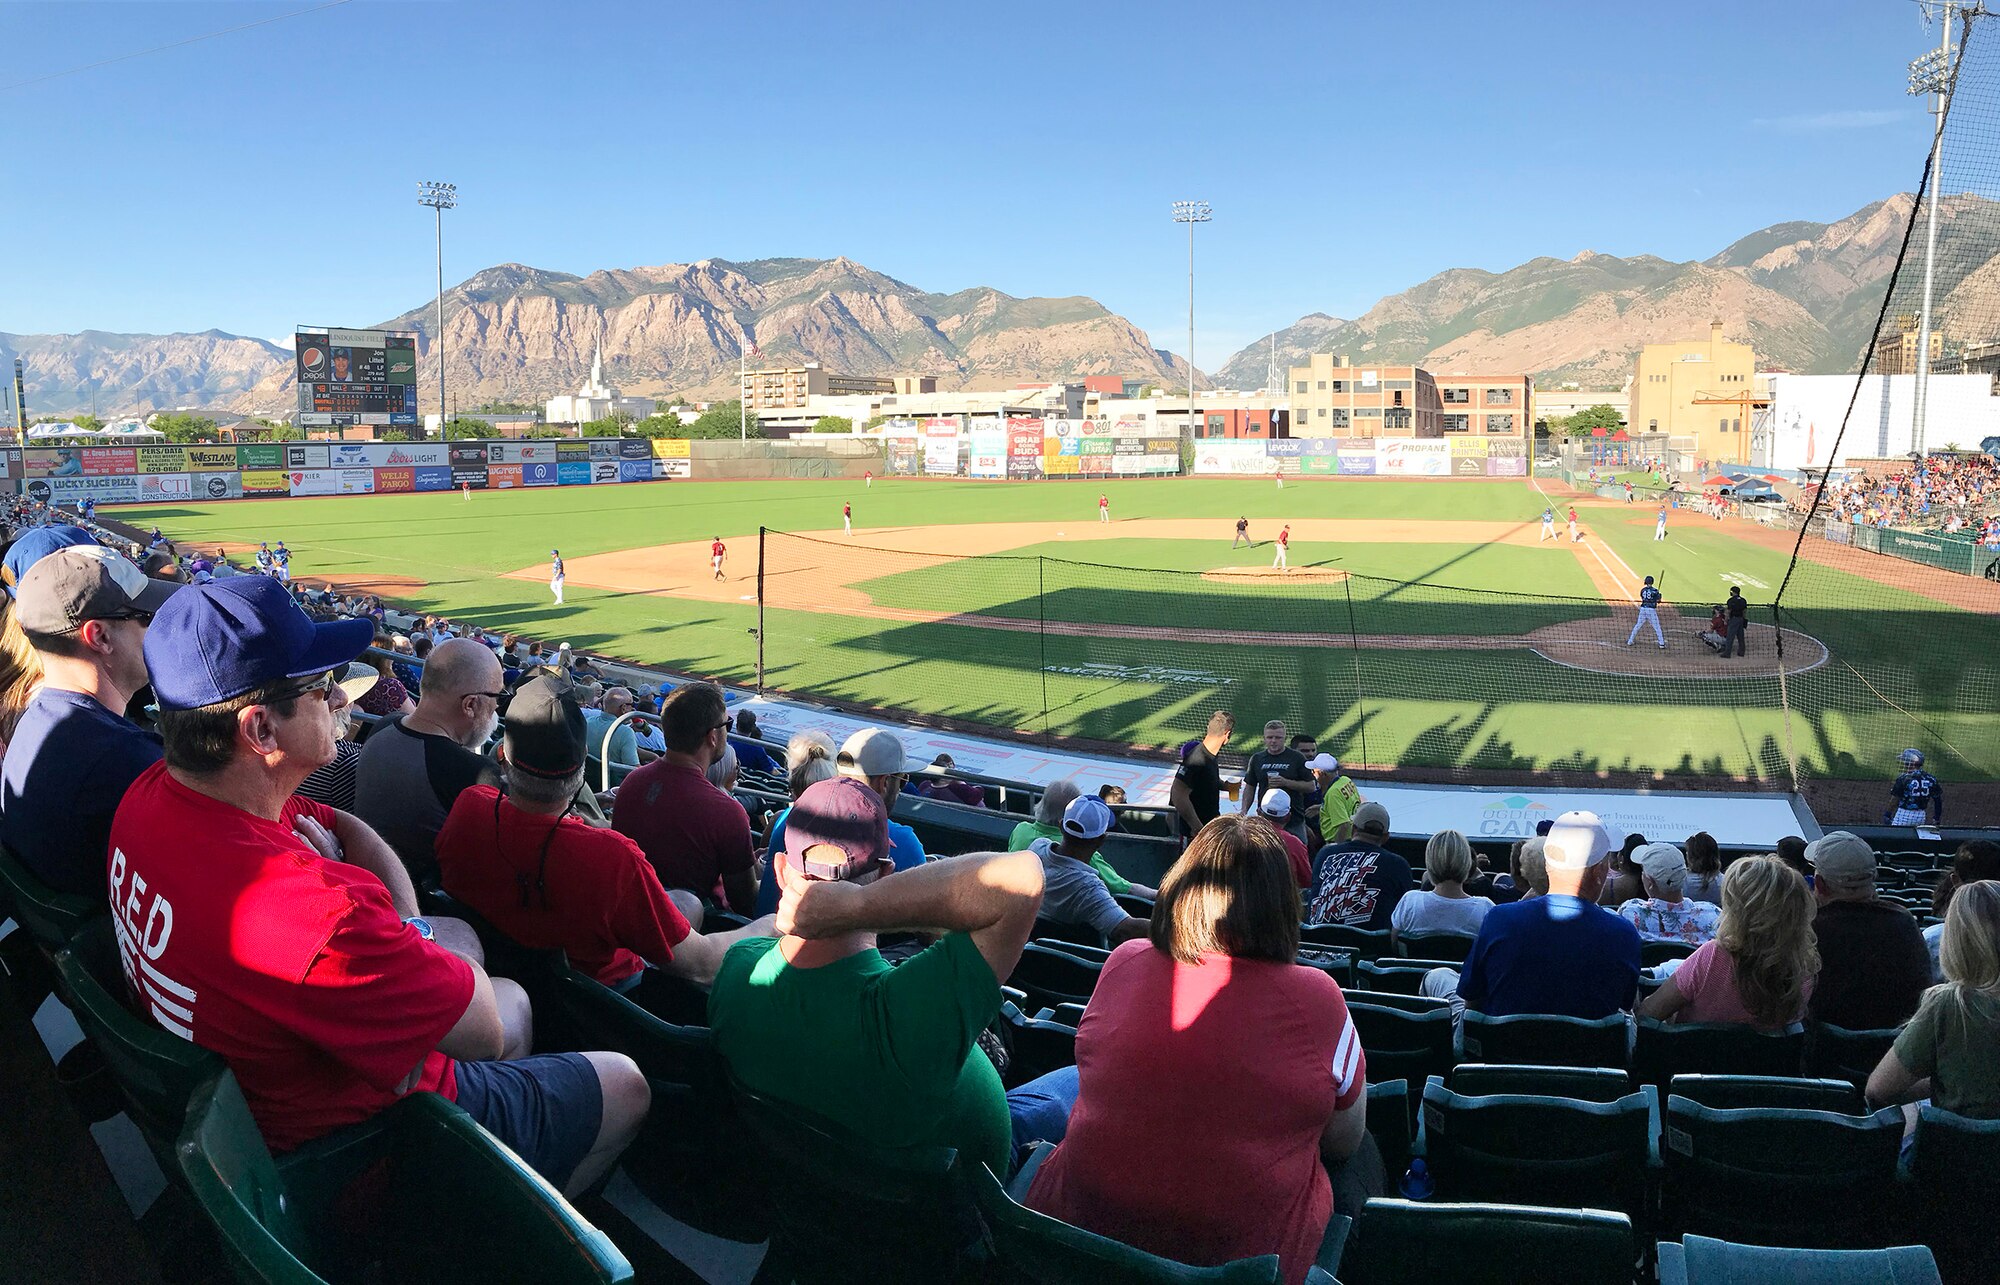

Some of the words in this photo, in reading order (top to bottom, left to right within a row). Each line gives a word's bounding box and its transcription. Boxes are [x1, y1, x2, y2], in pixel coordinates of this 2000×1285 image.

[330, 333, 364, 342] LINDQUIST
[303, 372, 326, 380] pepsi
[975, 423, 1002, 431] EPIC
[1094, 420, 1111, 434] 801
[190, 452, 236, 462] WESTLAND
[387, 451, 413, 464] Coors
[414, 454, 437, 462] LIGHT
[1230, 458, 1264, 471] WASATCH
[54, 480, 85, 489] LUCKY
[86, 479, 109, 488] SLICE
[112, 478, 138, 487] PIZZA
[160, 479, 188, 493] CTI
[381, 480, 410, 488] FARGO
[1642, 590, 1652, 599] 48
[1040, 666, 1151, 678] AMERICA
[1158, 674, 1239, 684] FIRST
[1911, 779, 1930, 796] 25
[1482, 808, 1546, 819] OGDEN
[1615, 812, 1665, 822] housing
[1615, 822, 1700, 831] communities
